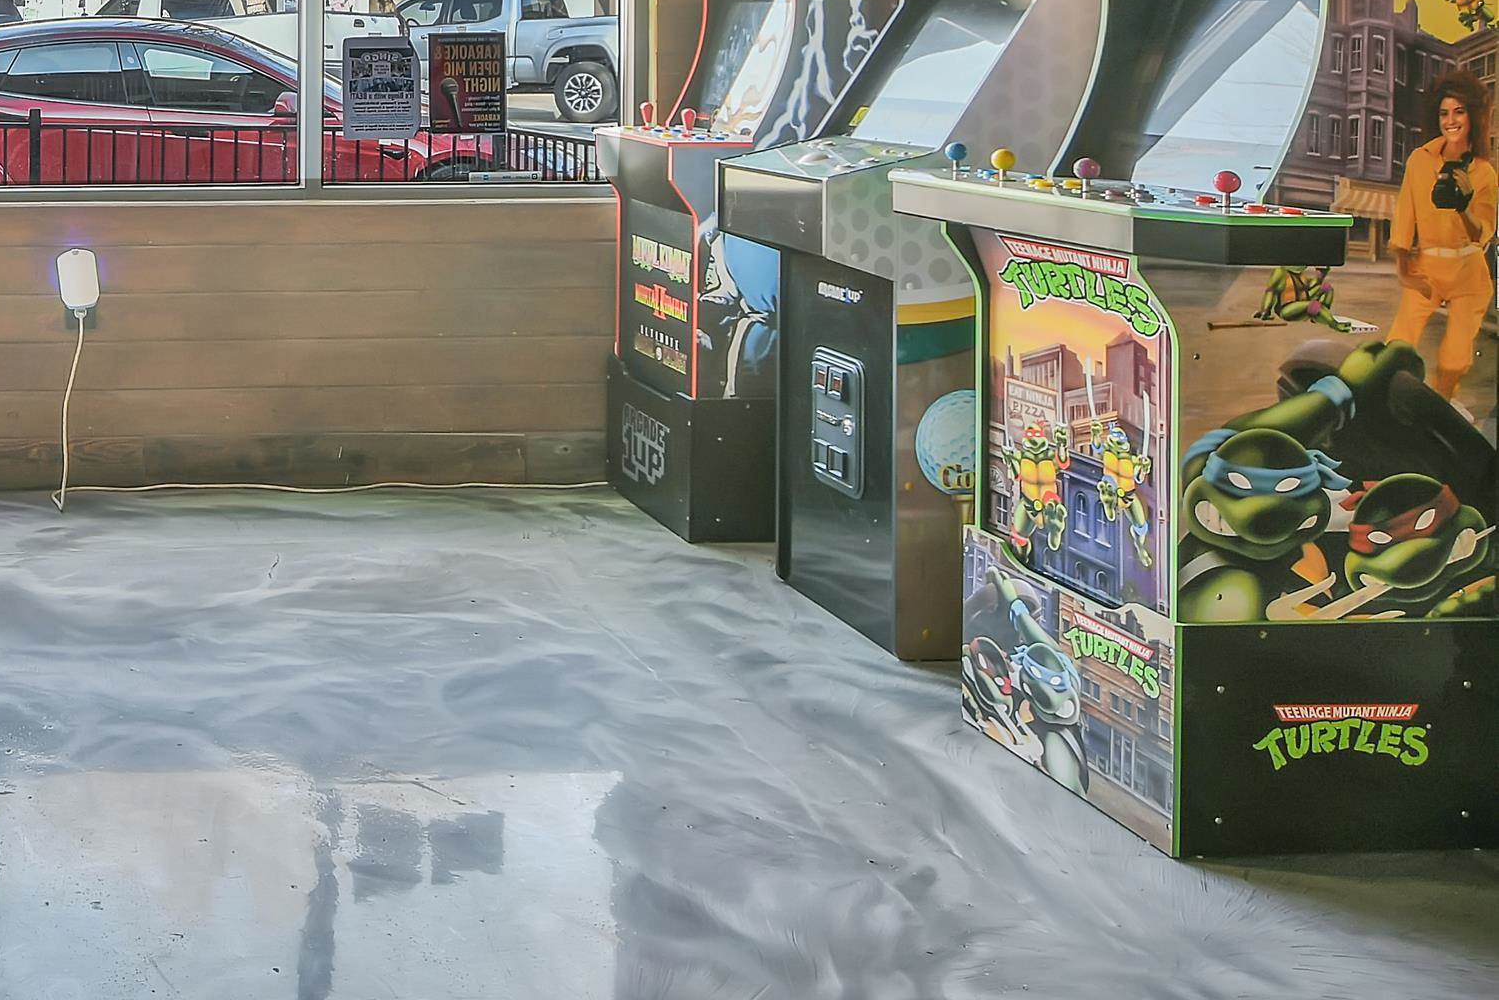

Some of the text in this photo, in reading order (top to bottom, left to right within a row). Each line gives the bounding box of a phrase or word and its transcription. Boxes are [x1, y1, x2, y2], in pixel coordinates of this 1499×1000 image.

[1092, 256, 1125, 275] NINJA
[999, 259, 1162, 337] TURTLES
[1013, 402, 1046, 419] PIZZA
[1063, 627, 1161, 698] TURTLES
[1275, 706, 1412, 719] TEENAGE MUTANT NINJA
[1253, 718, 1429, 770] TURTLES
